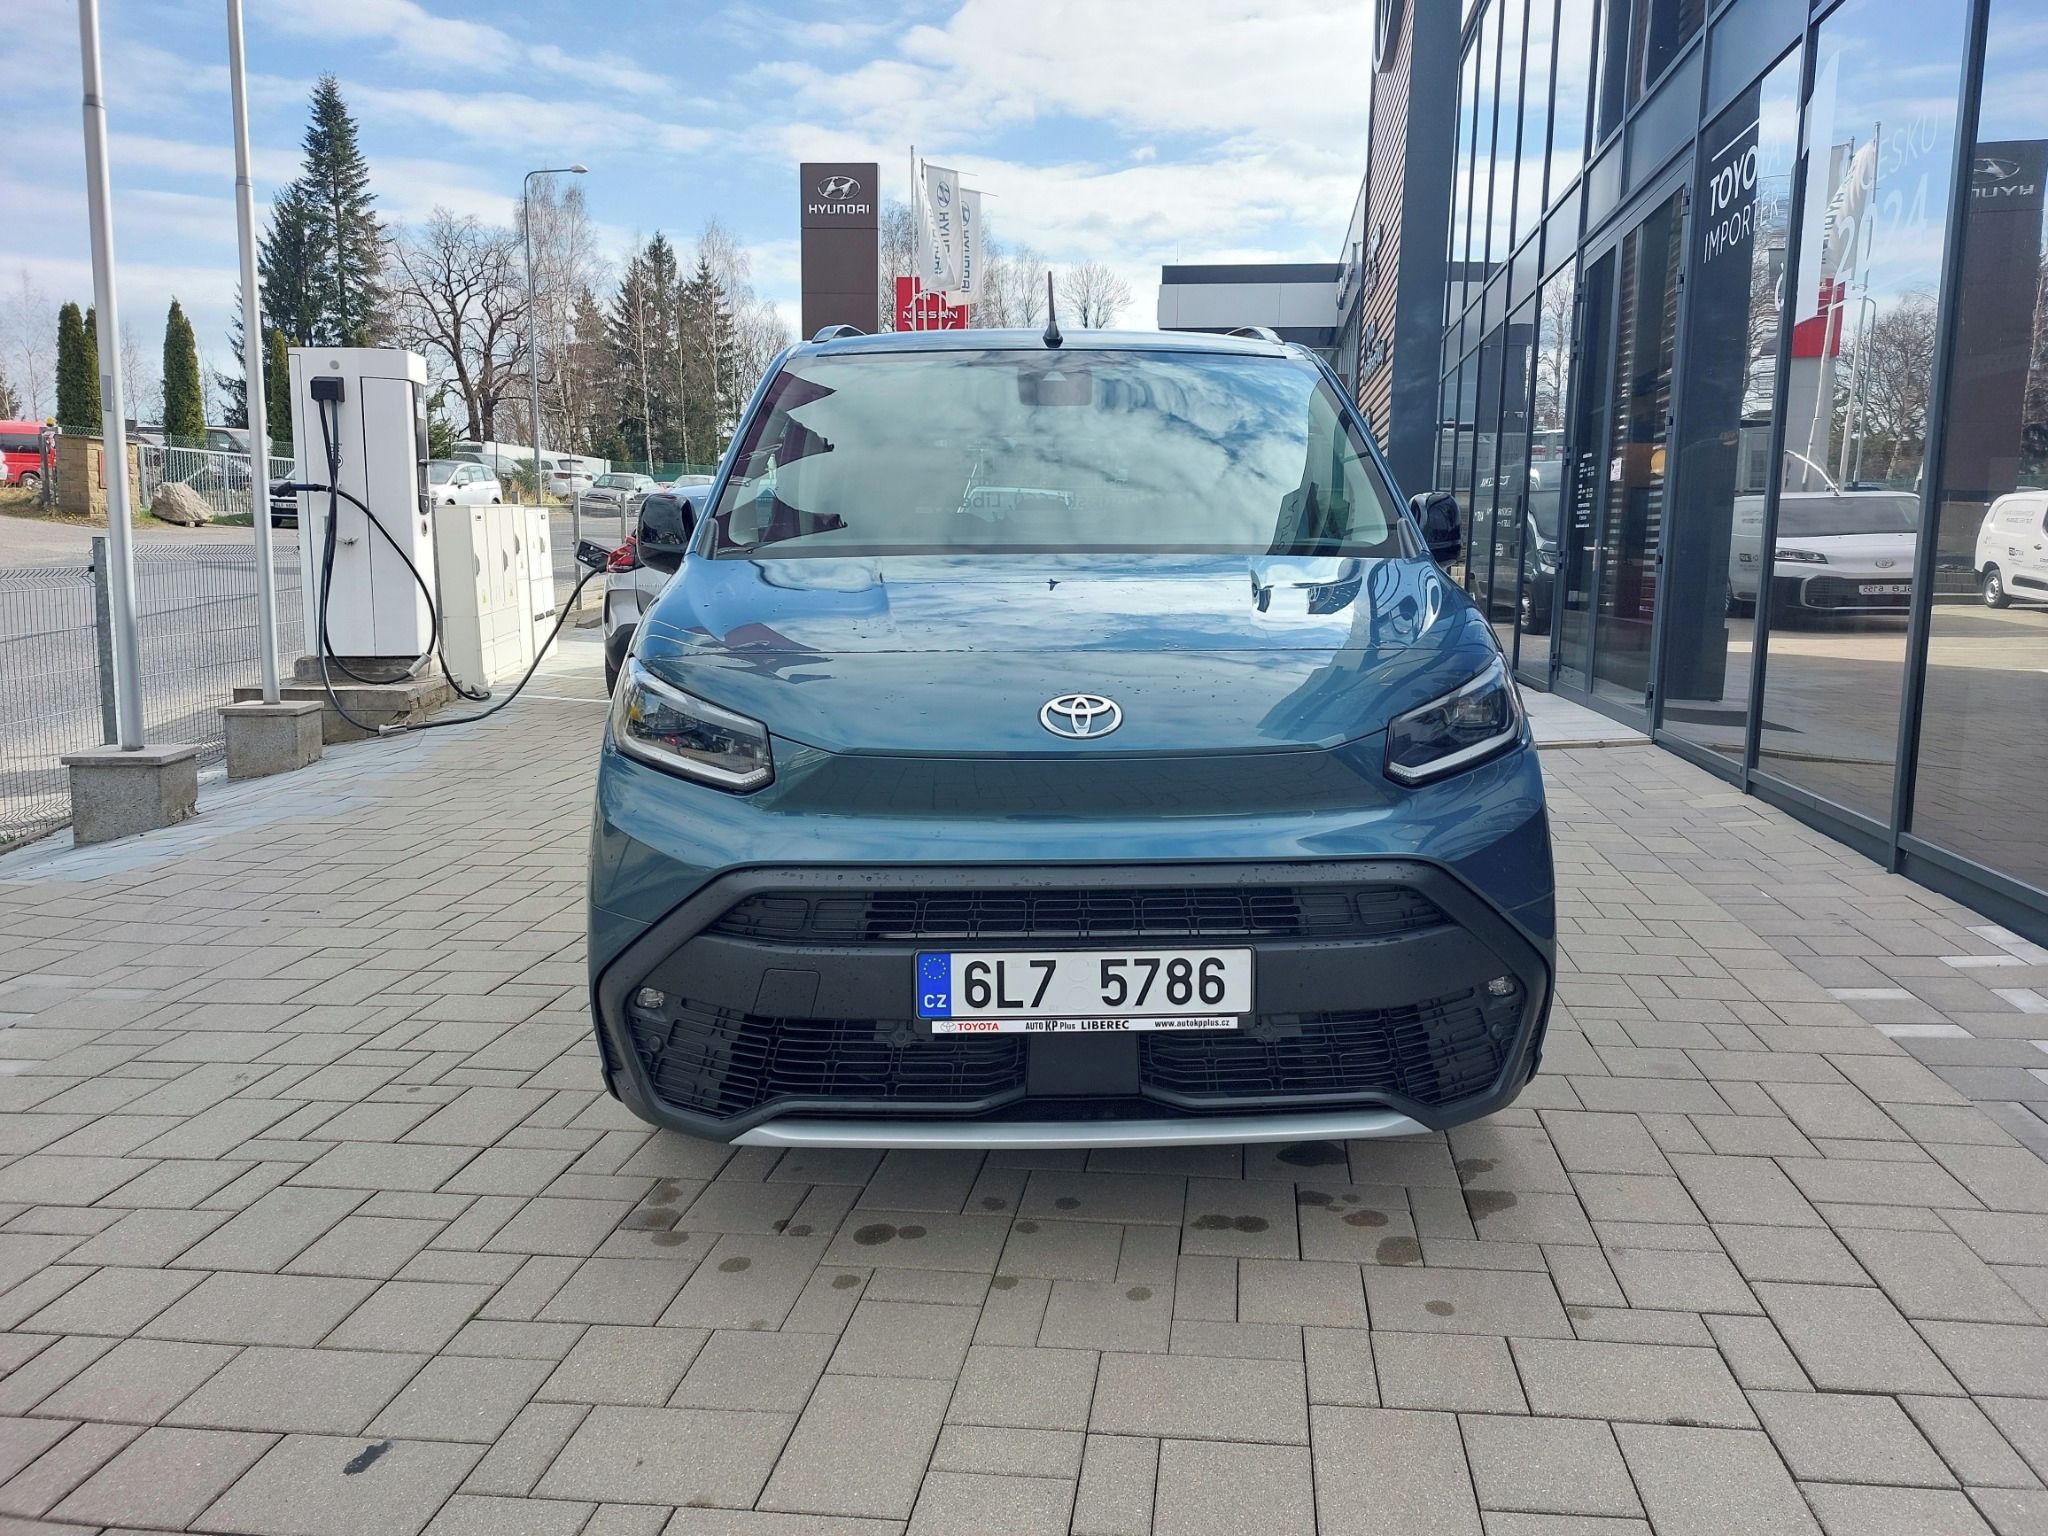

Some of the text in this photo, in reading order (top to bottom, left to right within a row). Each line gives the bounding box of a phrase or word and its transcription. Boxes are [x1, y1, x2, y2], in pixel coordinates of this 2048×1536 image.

[808, 204, 870, 214] HYUNDAI
[1703, 185, 1778, 263] IMPORTER
[902, 310, 958, 319] NSSAN
[963, 957, 1226, 1009] 6L7 5786
[924, 994, 947, 1009] CZ
[958, 1018, 1230, 1032] TOYOTA AUTO KP Plus LIBEREC www.autokpplus.cz
